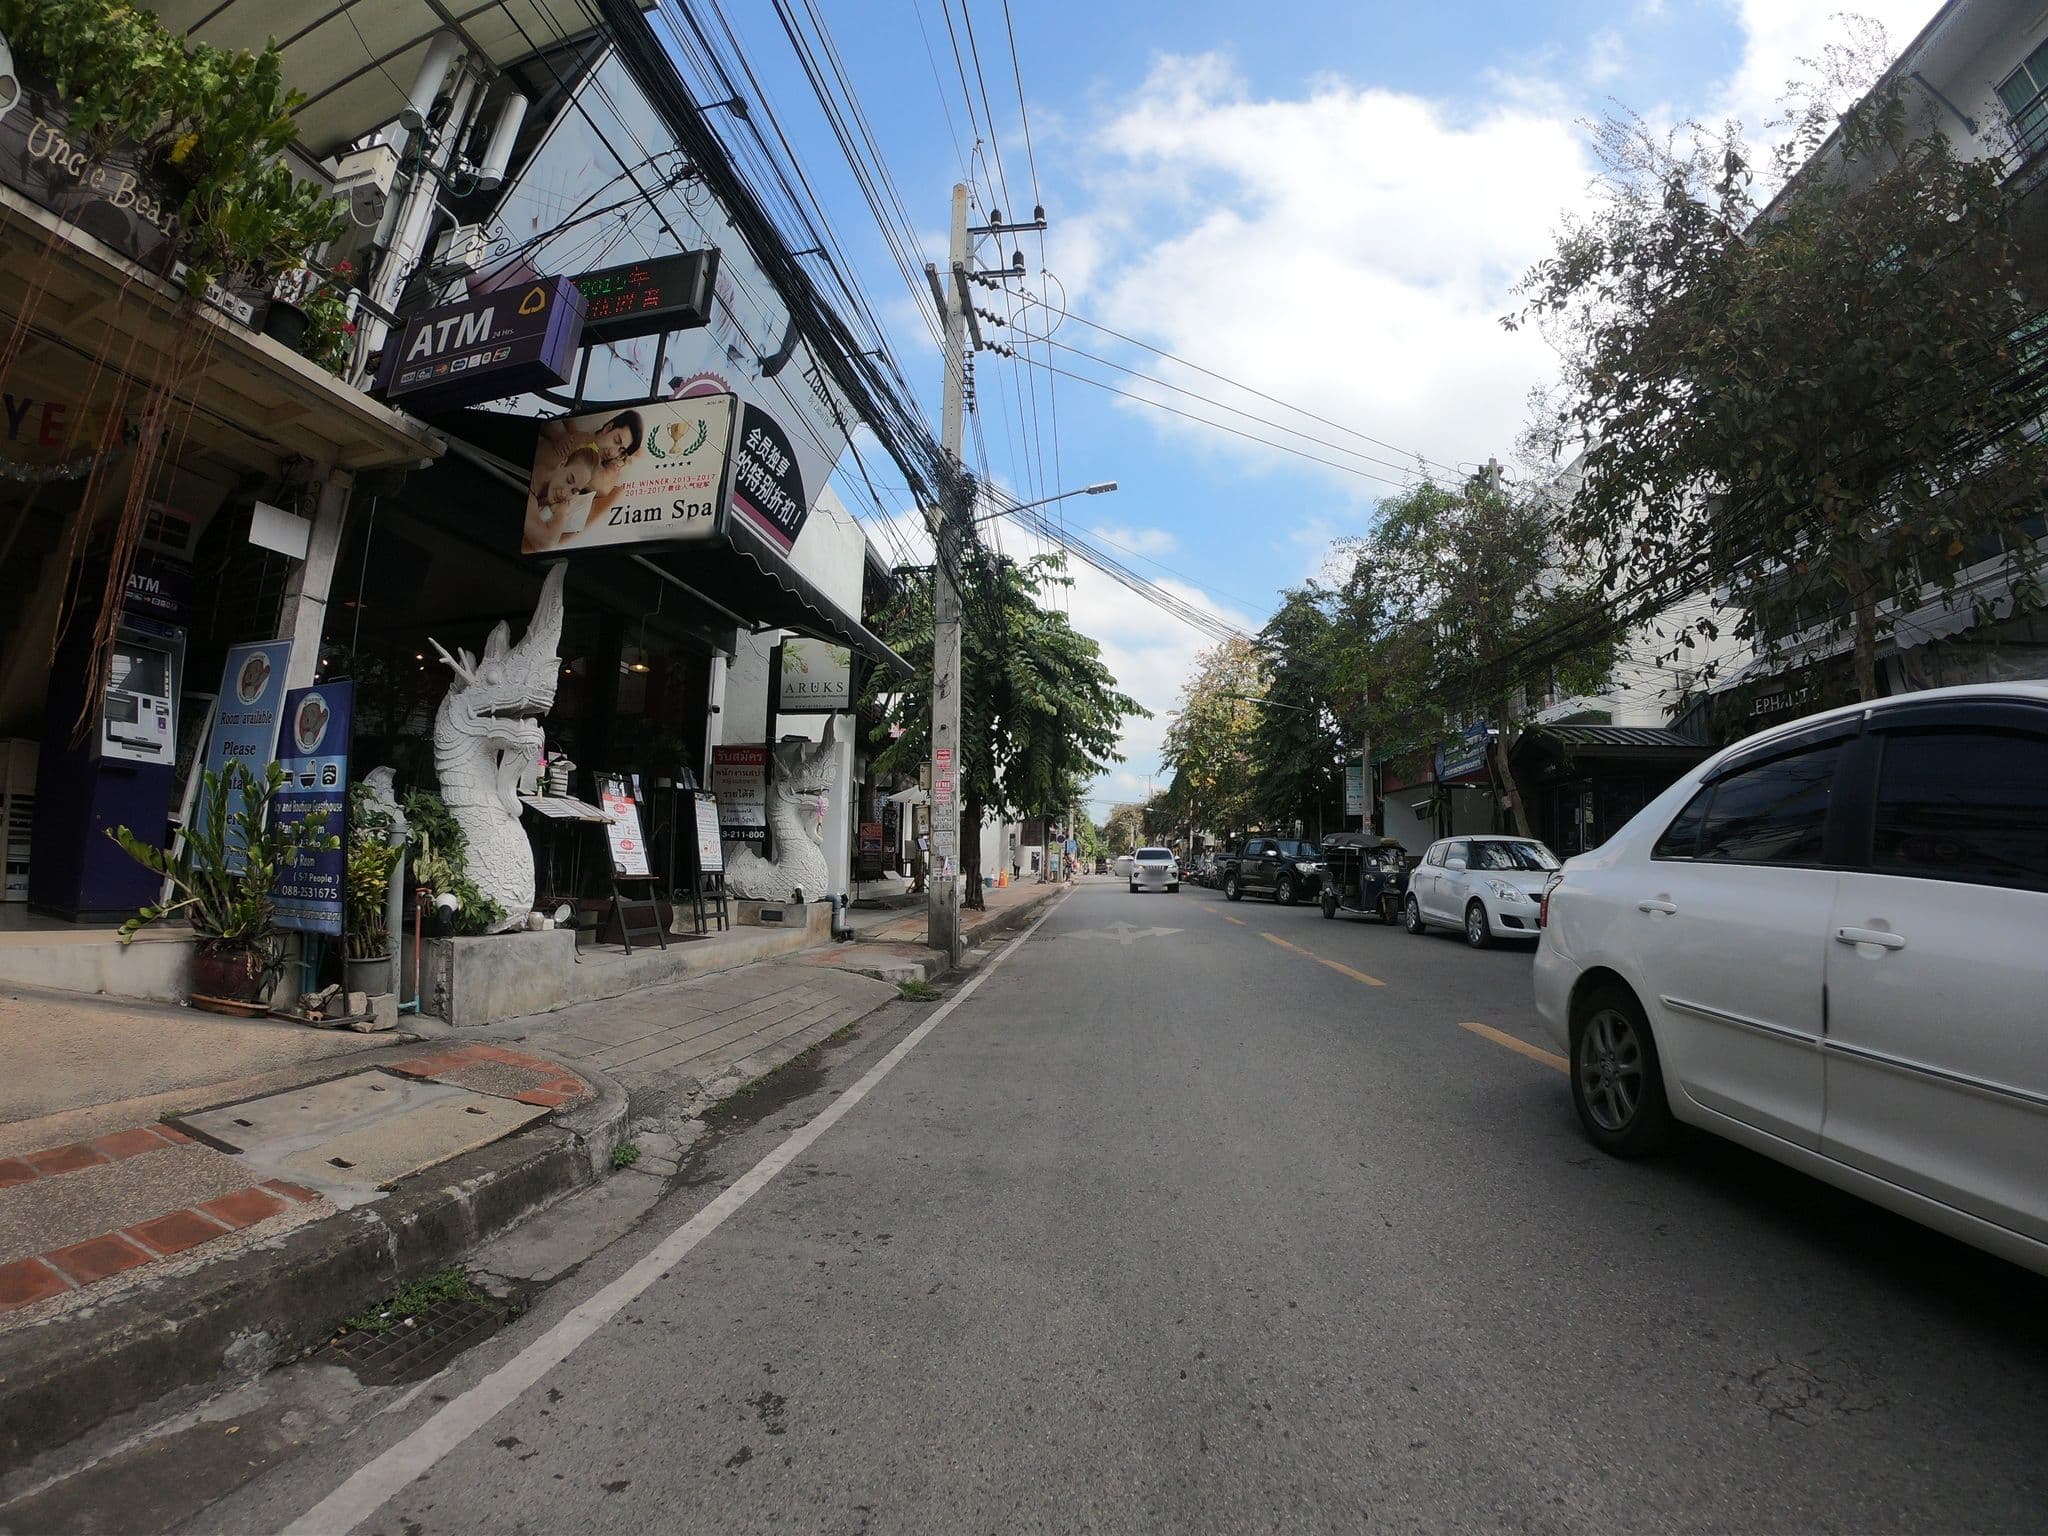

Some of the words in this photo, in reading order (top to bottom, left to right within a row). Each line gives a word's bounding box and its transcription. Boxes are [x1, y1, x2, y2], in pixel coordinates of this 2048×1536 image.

[406, 306, 495, 362] ATM
[746, 428, 791, 478] 会员独享
[640, 477, 669, 488] WINNER
[608, 505, 662, 527] Ziam
[671, 499, 713, 520] Spa
[126, 574, 160, 595] ATM
[785, 681, 844, 694] ARUKS
[220, 711, 240, 725] Room
[242, 710, 273, 724] available
[222, 741, 257, 756] Please
[717, 749, 763, 762] รับสมัคร
[309, 873, 333, 884] People
[282, 885, 338, 899] 088-2531675
